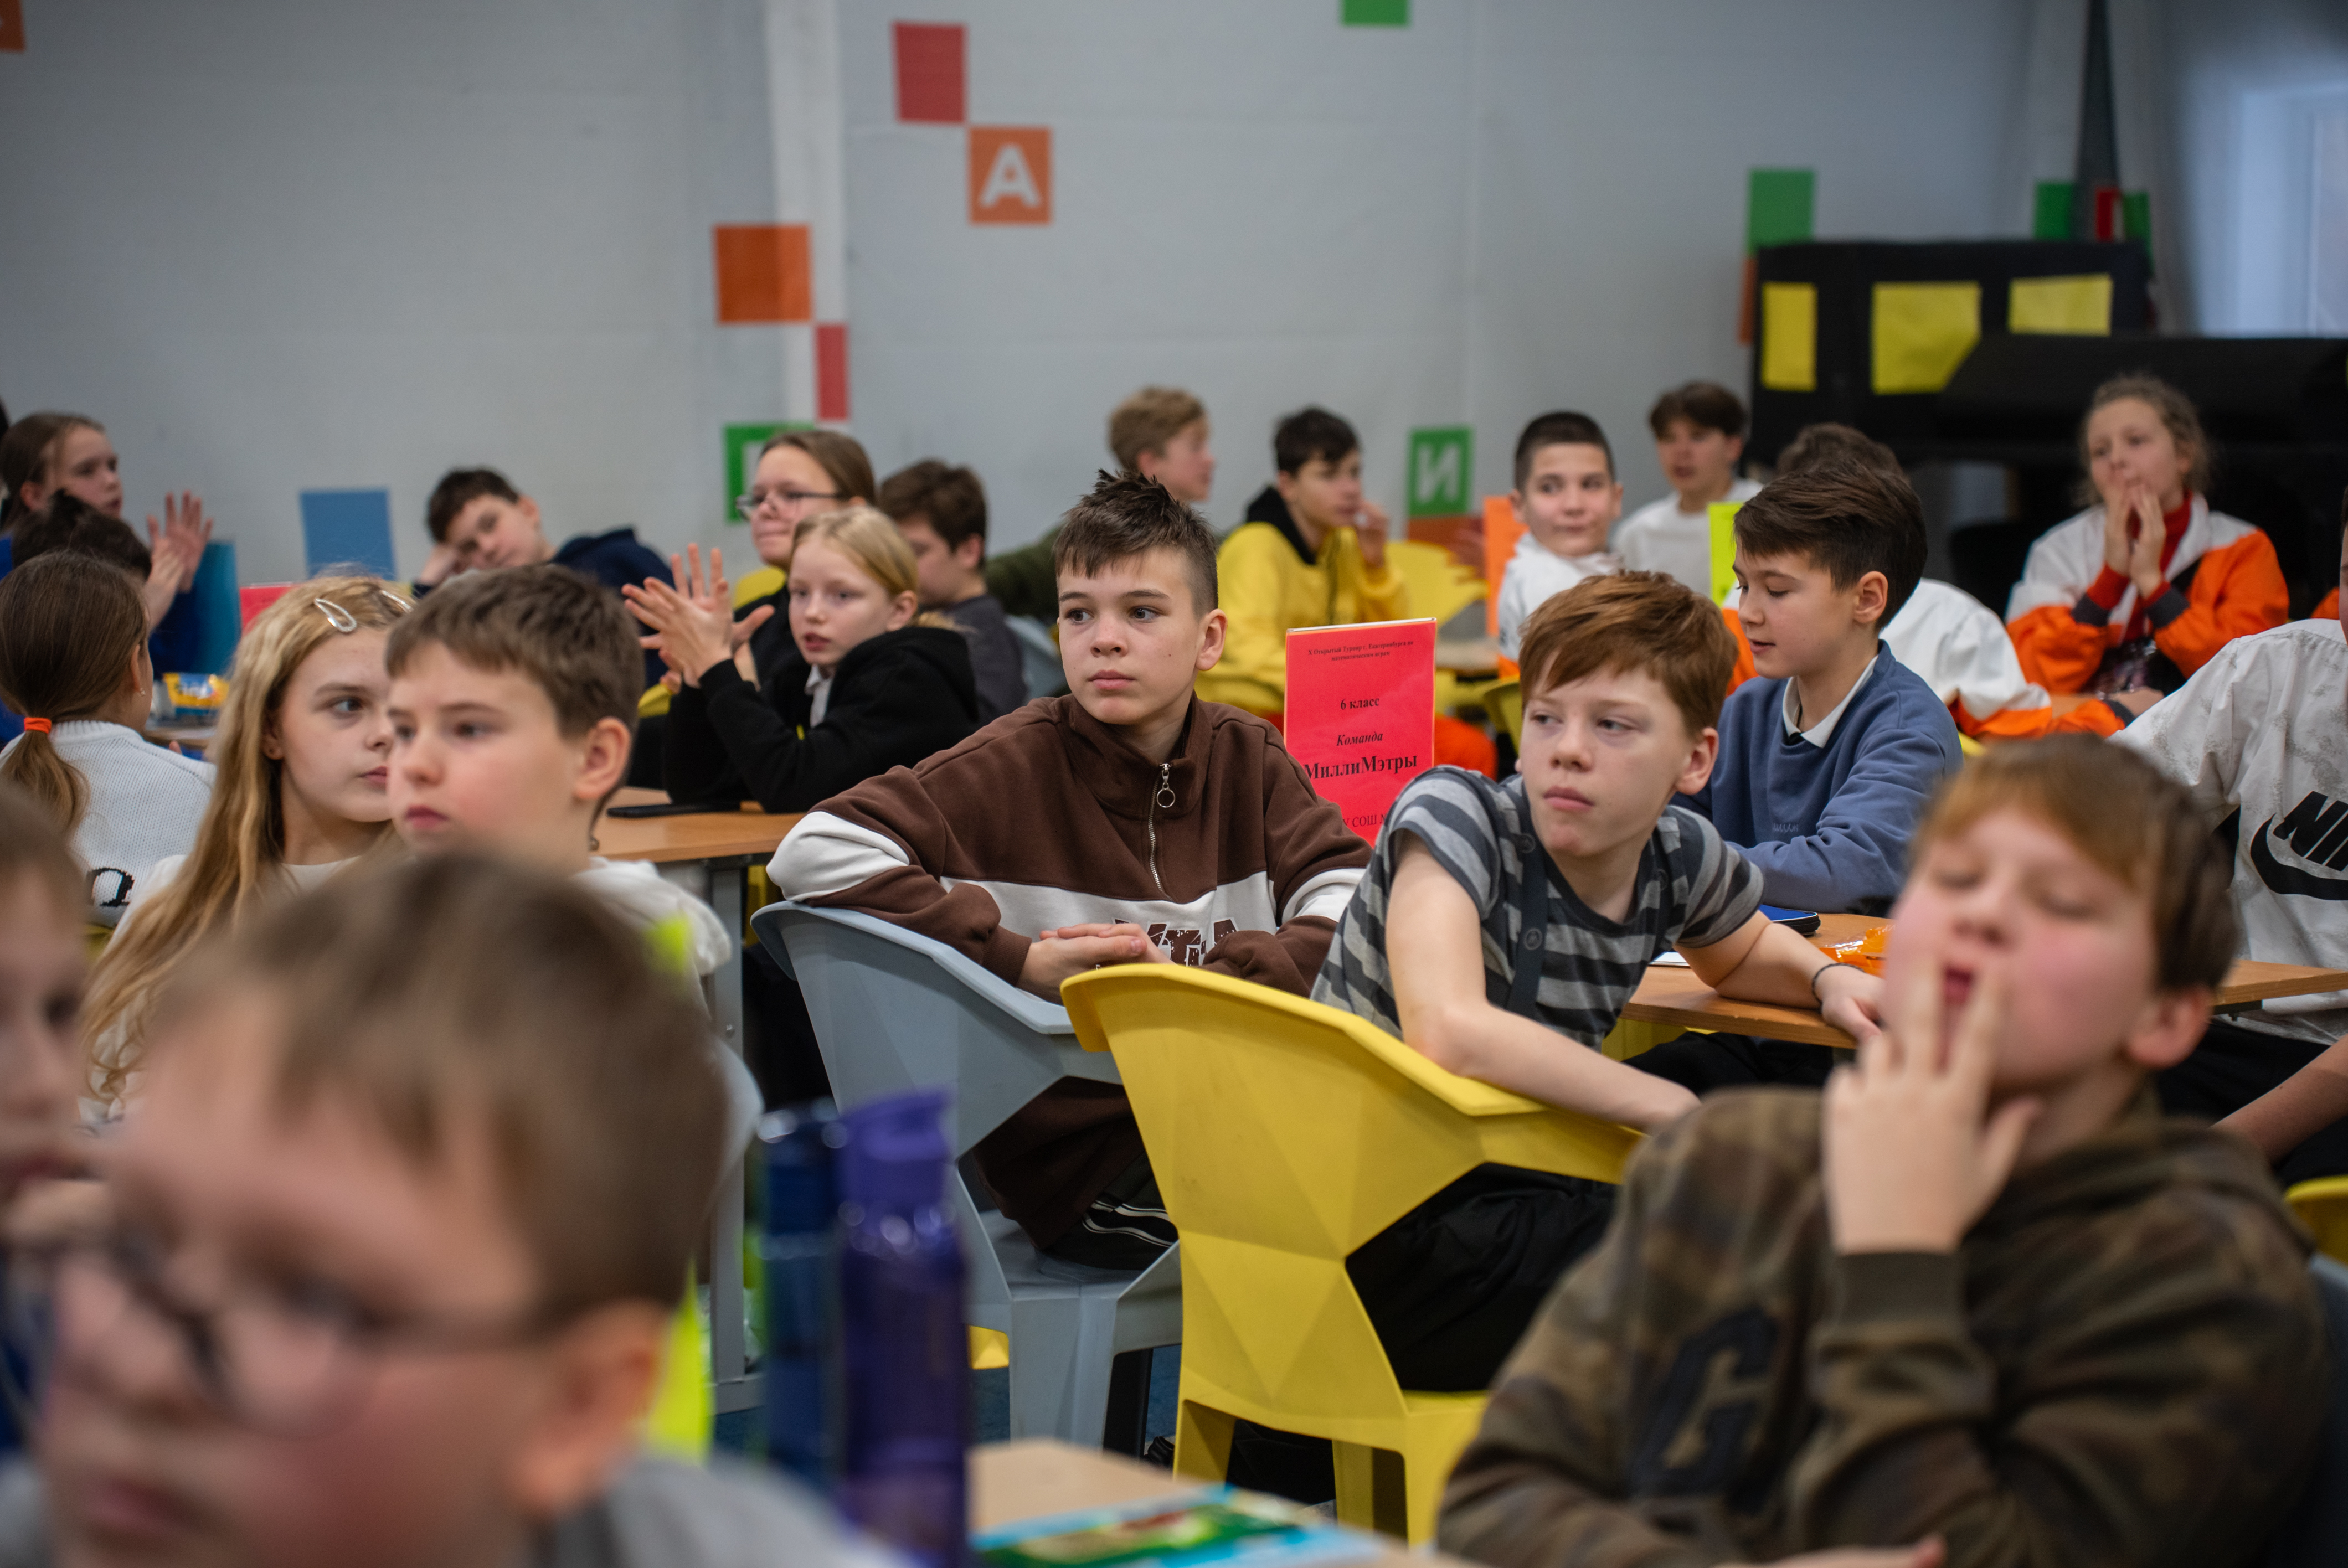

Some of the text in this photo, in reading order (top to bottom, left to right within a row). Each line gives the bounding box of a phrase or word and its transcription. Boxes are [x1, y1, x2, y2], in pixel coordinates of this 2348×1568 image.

[1416, 442, 1460, 504] И
[1314, 647, 1341, 655] Открытый
[1368, 641, 1407, 649] Екатеринбурга
[1331, 652, 1373, 661] математическим
[1340, 698, 1379, 710] 6 класс
[1336, 731, 1383, 746] Команда
[1304, 755, 1418, 780] МиллиМэтры
[1352, 814, 1377, 828] СОШ
